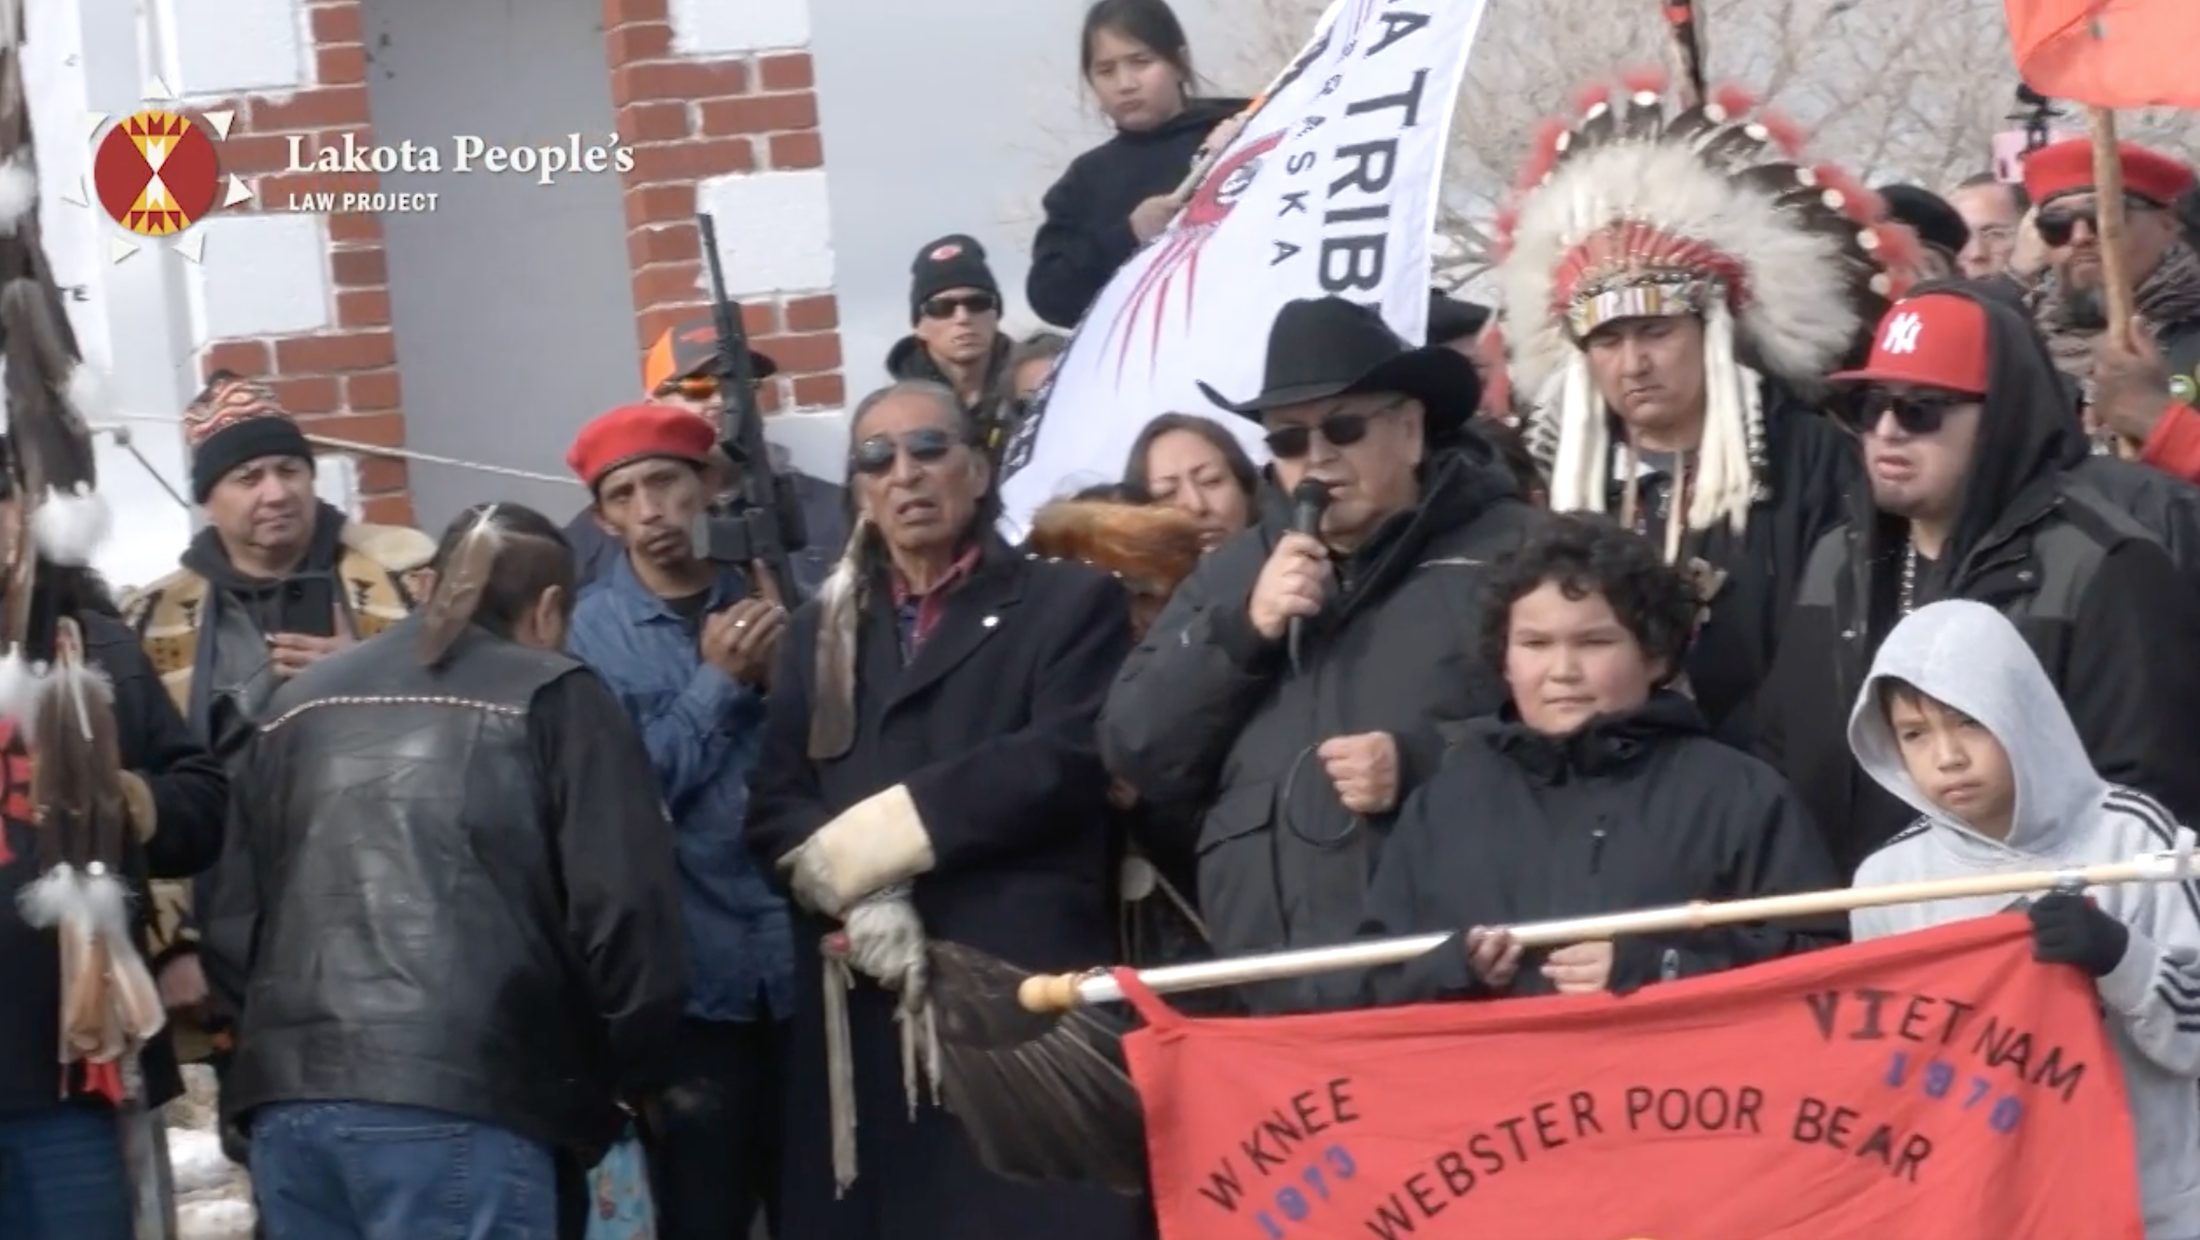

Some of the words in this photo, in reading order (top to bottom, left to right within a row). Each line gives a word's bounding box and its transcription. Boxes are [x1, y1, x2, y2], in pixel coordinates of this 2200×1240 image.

[1365, 0, 1431, 57] A
[1317, 66, 1431, 315] TRIB
[1197, 1156, 1245, 1213] W
[1239, 1076, 1361, 1177] KNEE
[1885, 1050, 2024, 1136] 1970
[1255, 1143, 1357, 1240] 1973
[1364, 1089, 1604, 1240] WEBSTER
[1624, 1084, 1765, 1135] POOR
[1792, 1096, 1934, 1183] BEAR
